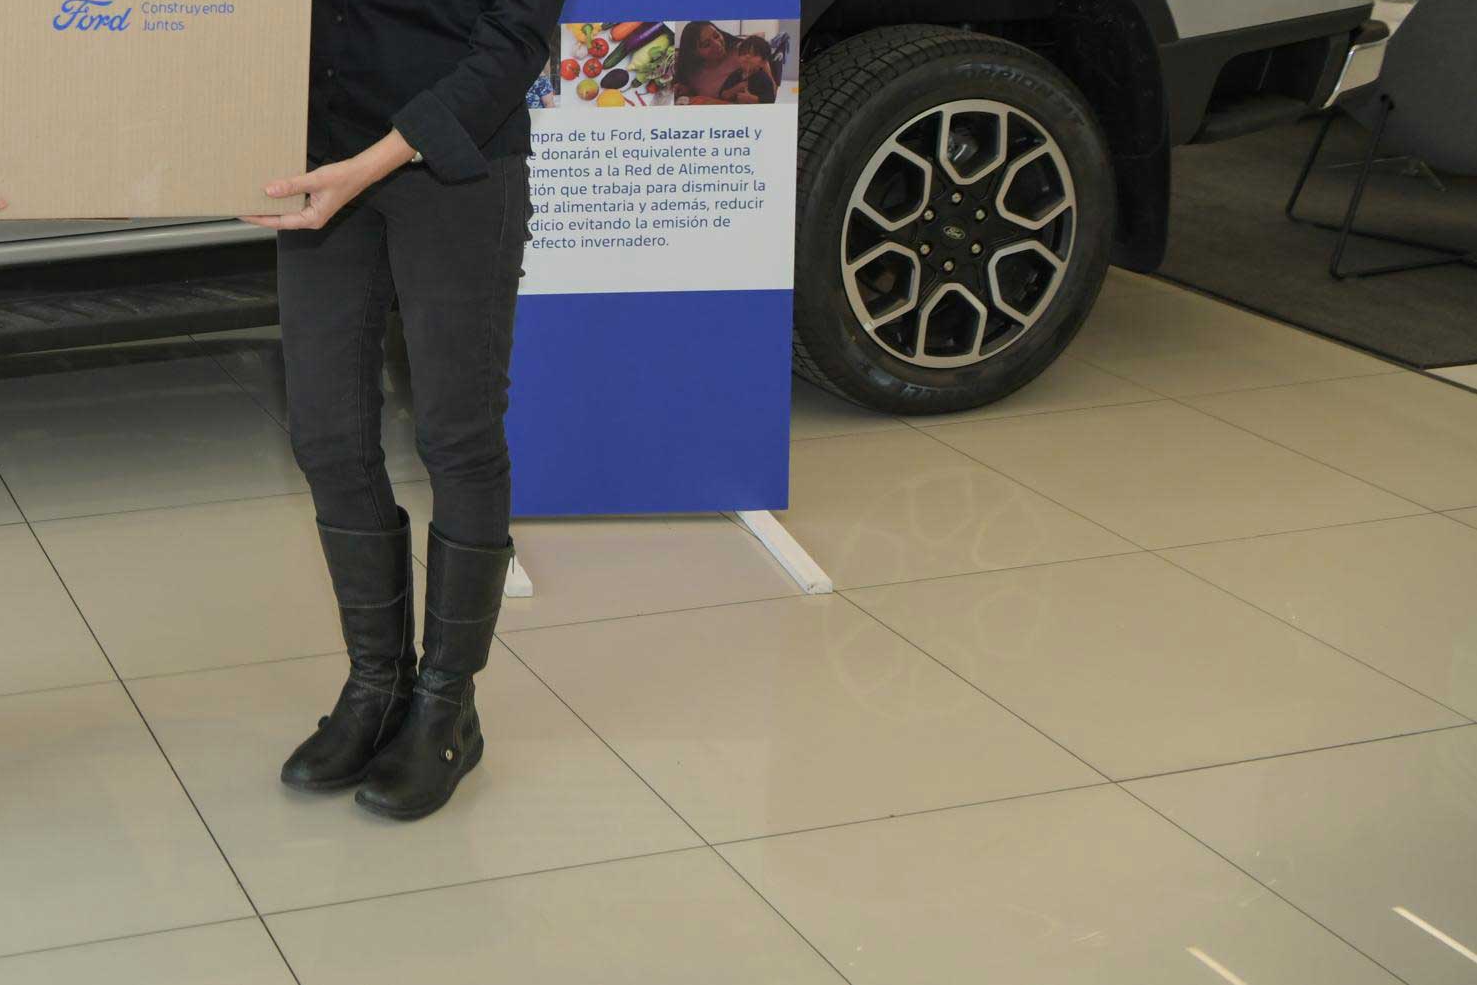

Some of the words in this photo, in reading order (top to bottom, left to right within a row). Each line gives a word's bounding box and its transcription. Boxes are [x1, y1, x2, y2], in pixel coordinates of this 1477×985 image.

[140, 0, 235, 15] Construyendo
[142, 19, 185, 32] Juntos
[531, 132, 563, 144] mpra
[568, 130, 586, 142] de
[591, 130, 606, 141] tu
[610, 129, 646, 143] Ford,
[650, 128, 705, 140] Salazar
[710, 127, 750, 139] Israel
[754, 128, 762, 140] y
[528, 151, 537, 161] e
[542, 147, 600, 161] donarán
[605, 146, 617, 159] el
[622, 145, 707, 160] equivalente
[711, 147, 719, 157] a
[724, 146, 750, 157] una
[594, 167, 603, 177] a
[607, 165, 620, 177] la
[624, 164, 652, 176] Red
[656, 163, 674, 176] de
[678, 162, 755, 176] Alimentos,
[560, 185, 588, 197] que
[592, 182, 641, 196] trabaja
[646, 183, 677, 196] para
[681, 180, 749, 193] disminuir
[753, 180, 766, 192] la
[533, 202, 549, 214] ad
[554, 200, 634, 214] alimentaria
[638, 202, 647, 214] y
[651, 198, 710, 212] además,
[715, 197, 764, 210] reducir
[568, 217, 631, 231] evitando
[635, 217, 648, 230] la
[652, 215, 708, 229] emisión
[713, 215, 731, 228] de
[532, 237, 576, 249] efecto
[581, 235, 669, 248] invernadero.
